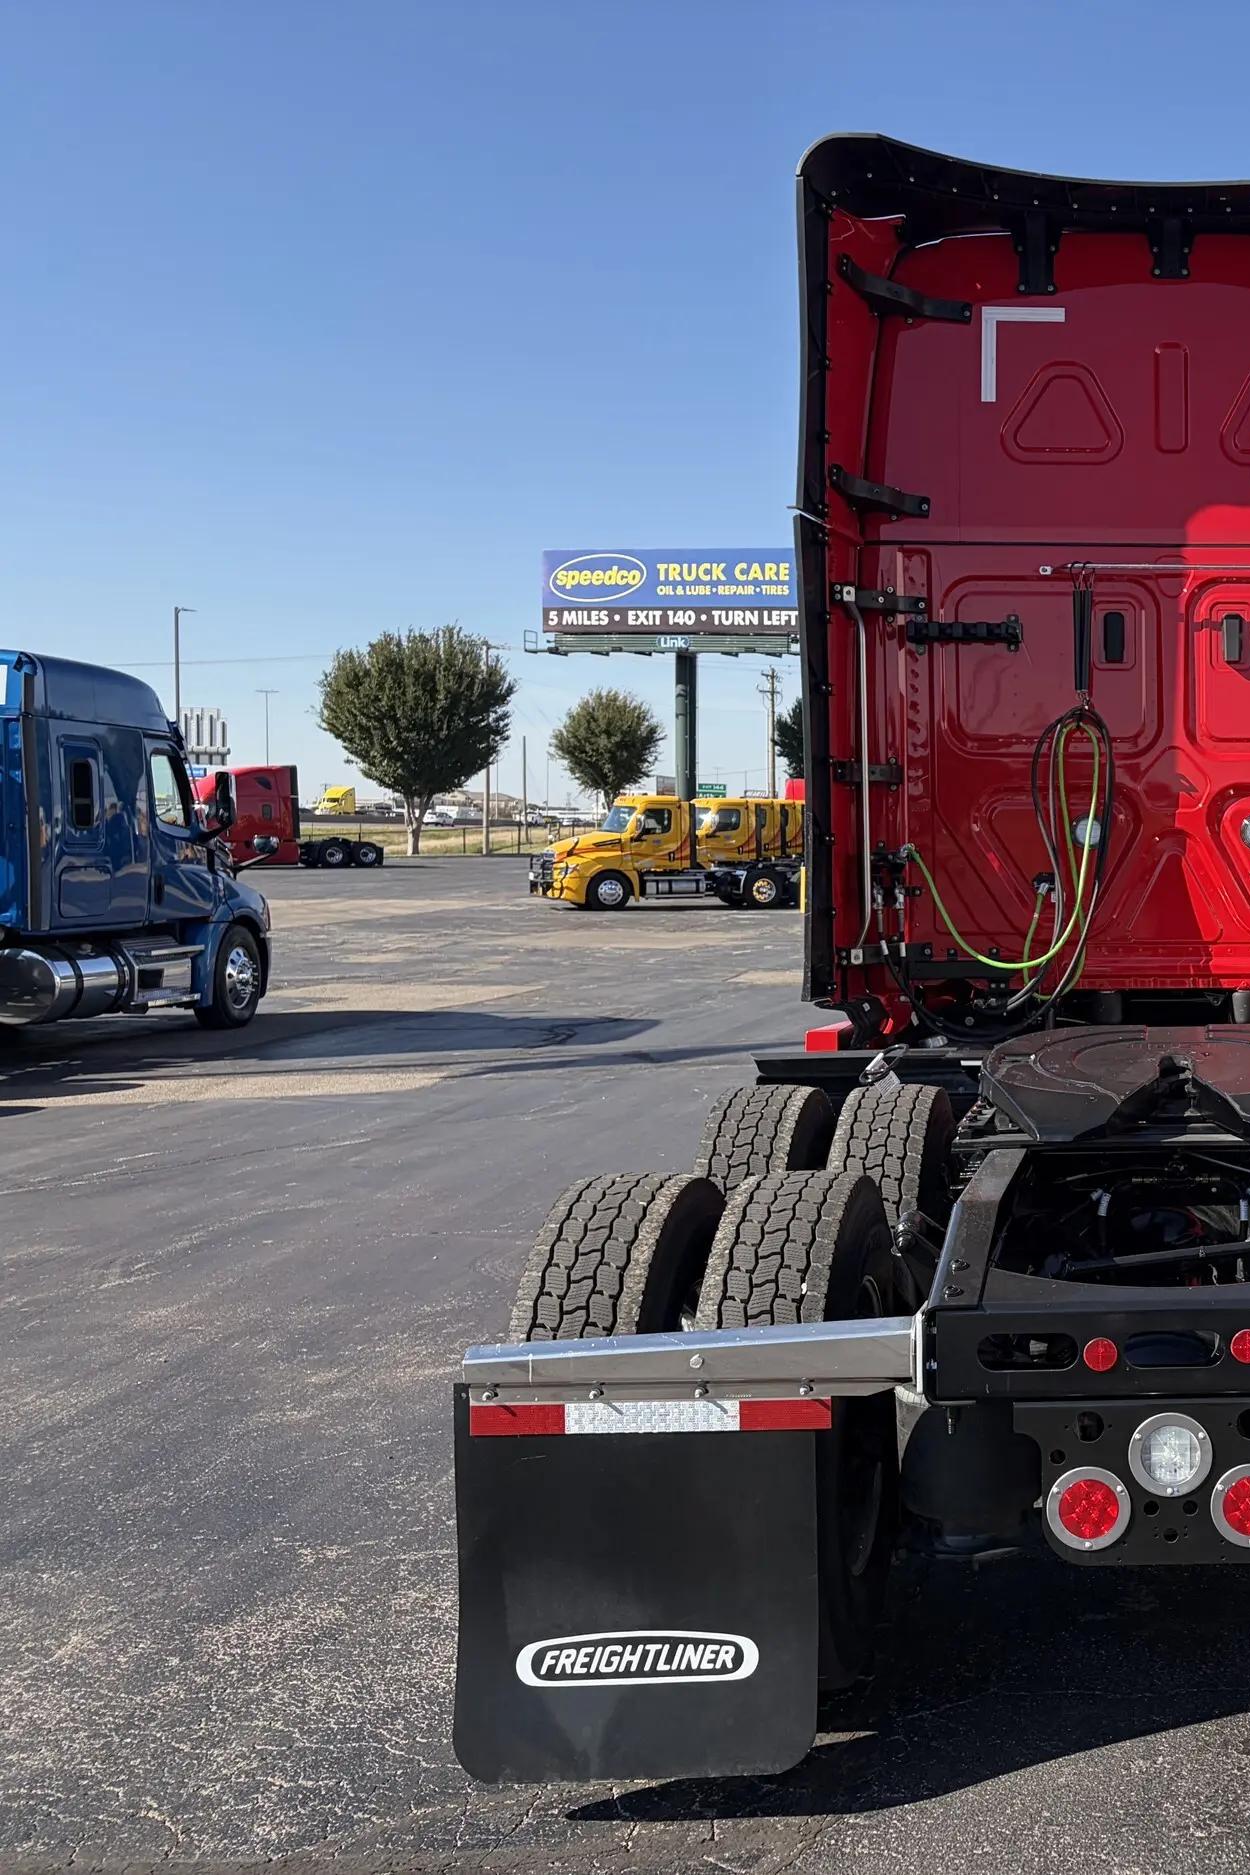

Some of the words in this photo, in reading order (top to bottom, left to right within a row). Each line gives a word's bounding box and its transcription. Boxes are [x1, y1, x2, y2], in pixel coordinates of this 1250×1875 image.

[555, 565, 641, 588] speedco
[657, 563, 724, 581] TRUCK
[734, 563, 790, 581] CARE
[657, 586, 674, 596] OIL
[676, 586, 684, 595] &
[686, 585, 711, 595] LUBE
[718, 585, 755, 595] REPAIR
[761, 585, 790, 595] TIRES
[548, 611, 558, 625] 5
[562, 611, 609, 625] MILES
[628, 611, 662, 625] EXIT
[667, 610, 695, 625] 140
[712, 610, 759, 625] TURN
[764, 610, 798, 625] LEFT
[660, 636, 687, 648] Link
[540, 1643, 736, 1675] FREIGHTLINER
